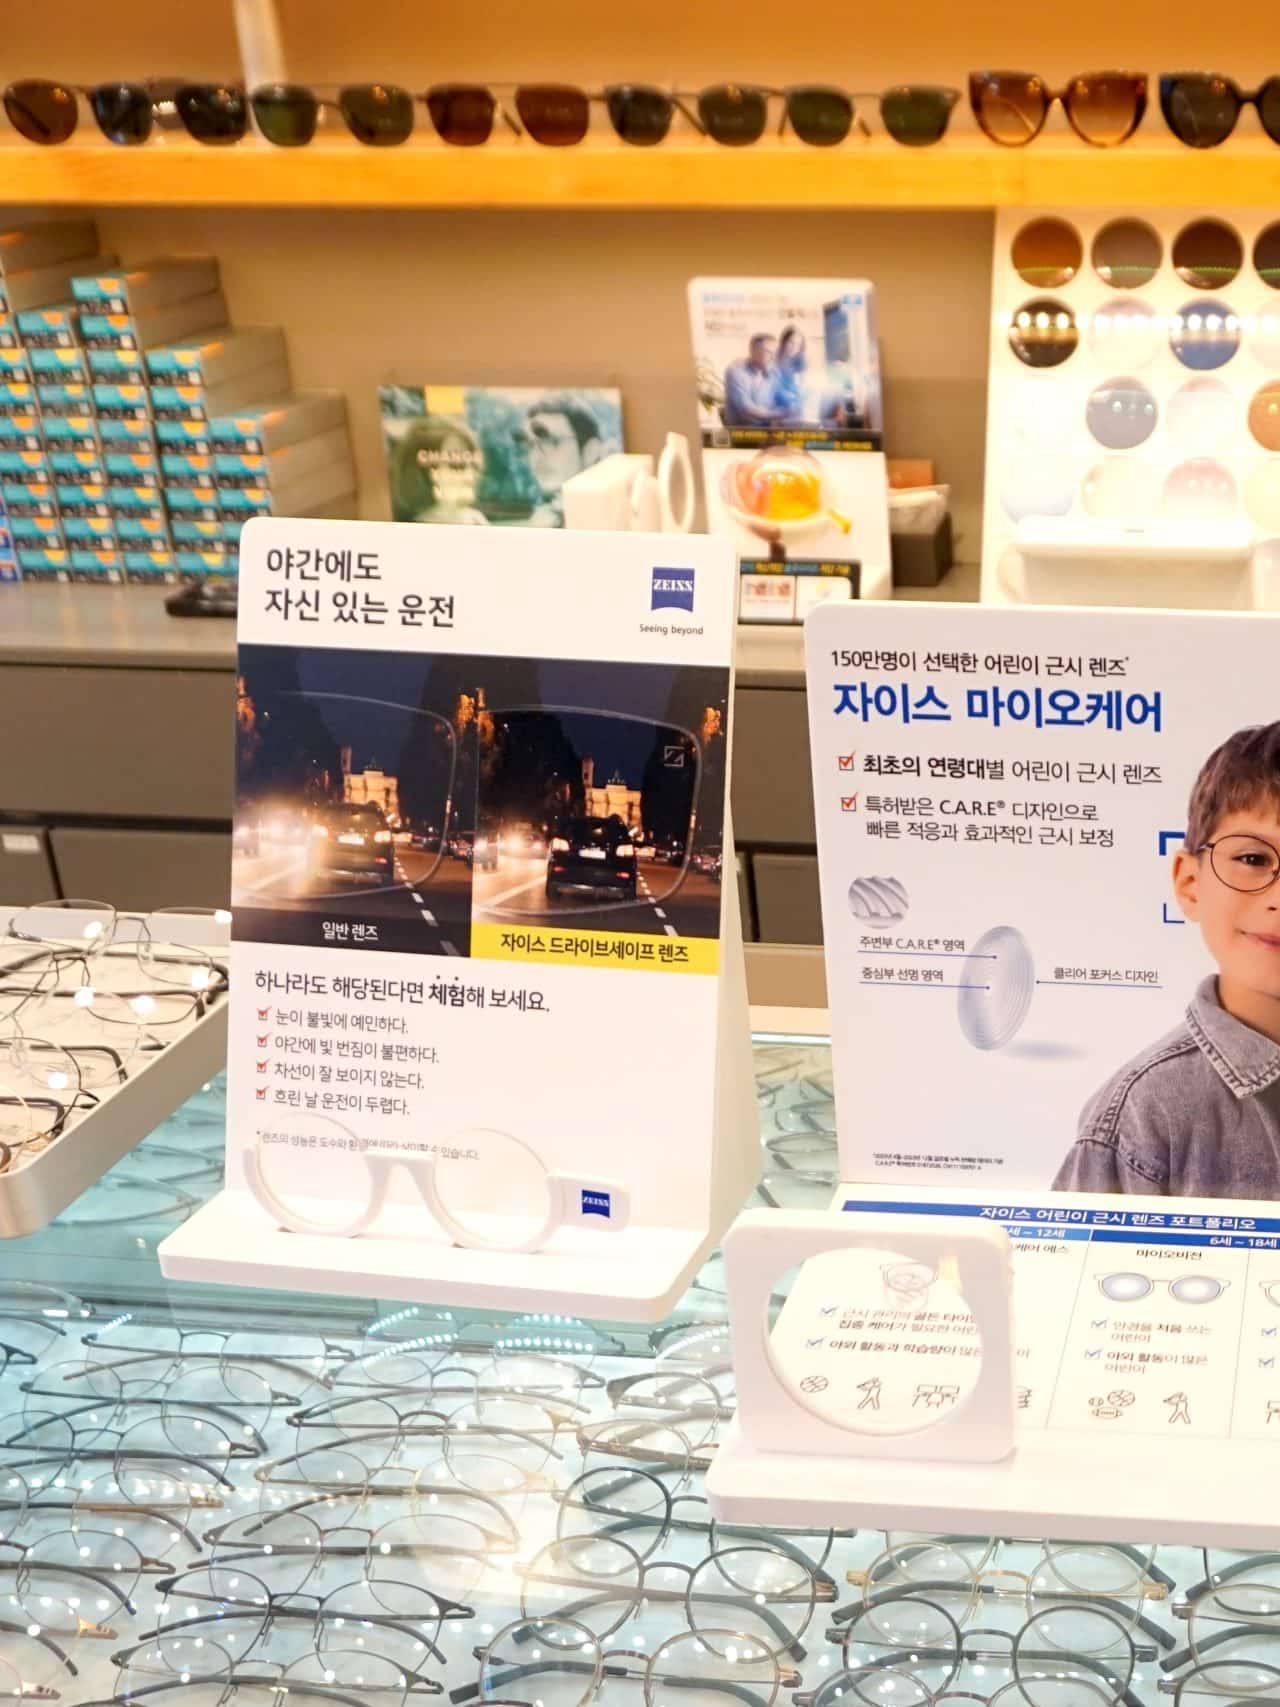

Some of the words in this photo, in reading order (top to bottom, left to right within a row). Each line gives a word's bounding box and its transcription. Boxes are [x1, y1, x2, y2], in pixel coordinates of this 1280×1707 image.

[266, 547, 382, 582] 야간에도
[653, 578, 693, 592] ZEISS
[265, 588, 320, 622] 자신
[332, 591, 389, 625] 있는
[397, 594, 454, 628] 운전
[639, 623, 668, 636] Seeing
[671, 625, 704, 637] beyond
[831, 650, 917, 671] 150만명이
[923, 653, 979, 673] 선택한
[985, 653, 1039, 676] 어린이
[1044, 656, 1083, 677] 근시
[832, 681, 952, 724] 자이스
[966, 685, 1162, 733] 마이오케어
[863, 755, 921, 777] 최초의
[927, 756, 1005, 780] 연령대별
[1012, 760, 1071, 783] 어린이
[1076, 761, 1116, 784] 근시
[1123, 764, 1163, 786] 렌즈
[865, 796, 934, 818] 특허받은
[1012, 801, 1100, 822] 디자인으로
[866, 820, 902, 840] 빠른
[907, 821, 958, 842] 적응과
[963, 824, 1033, 845] 효과적인
[1038, 826, 1073, 847] 근시
[1079, 828, 1115, 848] 보정
[322, 921, 349, 942] 일반
[351, 922, 378, 942] 렌즈
[859, 935, 893, 950] 주변부
[942, 938, 965, 952] 영역
[501, 933, 546, 954] 자이스
[549, 936, 655, 961] 드라이브세이프
[658, 941, 689, 963] 렌즈
[862, 967, 895, 980] 중심부
[897, 967, 920, 981] 선명
[921, 968, 944, 982] 영역
[1053, 967, 1088, 980] 클리어
[1089, 967, 1123, 982] 포커스
[1125, 968, 1158, 983] 디자인
[255, 970, 328, 996] 하나라도
[332, 975, 424, 1005] 해당된다면
[428, 983, 485, 1008] 체험해
[488, 988, 551, 1013] 보세요.
[275, 1007, 303, 1026] 눈이
[306, 1010, 348, 1030] 불빛에
[350, 1013, 409, 1035] 예민하다.
[274, 1035, 316, 1055] 야간에
[320, 1038, 333, 1056] 빛
[336, 1039, 377, 1060] 번짐이
[380, 1043, 439, 1064] 불편하다.
[273, 1062, 315, 1082] 차선이
[319, 1064, 333, 1083] 잘
[335, 1066, 377, 1087] 보이지
[380, 1069, 425, 1090] 않는다.
[273, 1088, 301, 1108] 흐린
[304, 1090, 318, 1109] 날
[320, 1091, 362, 1113] 운전이
[365, 1095, 410, 1116] 두렵다.
[583, 1196, 609, 1207] ZEISS
[980, 1206, 1031, 1221] 자이스
[1036, 1209, 1087, 1224] 어린이
[1093, 1212, 1126, 1226] 근시
[1131, 1213, 1165, 1227] 렌즈
[1169, 1215, 1257, 1230] 포트폴리오
[1036, 1228, 1066, 1238] 12세
[1209, 1236, 1232, 1247] 6세
[1248, 1238, 1278, 1249] 18세
